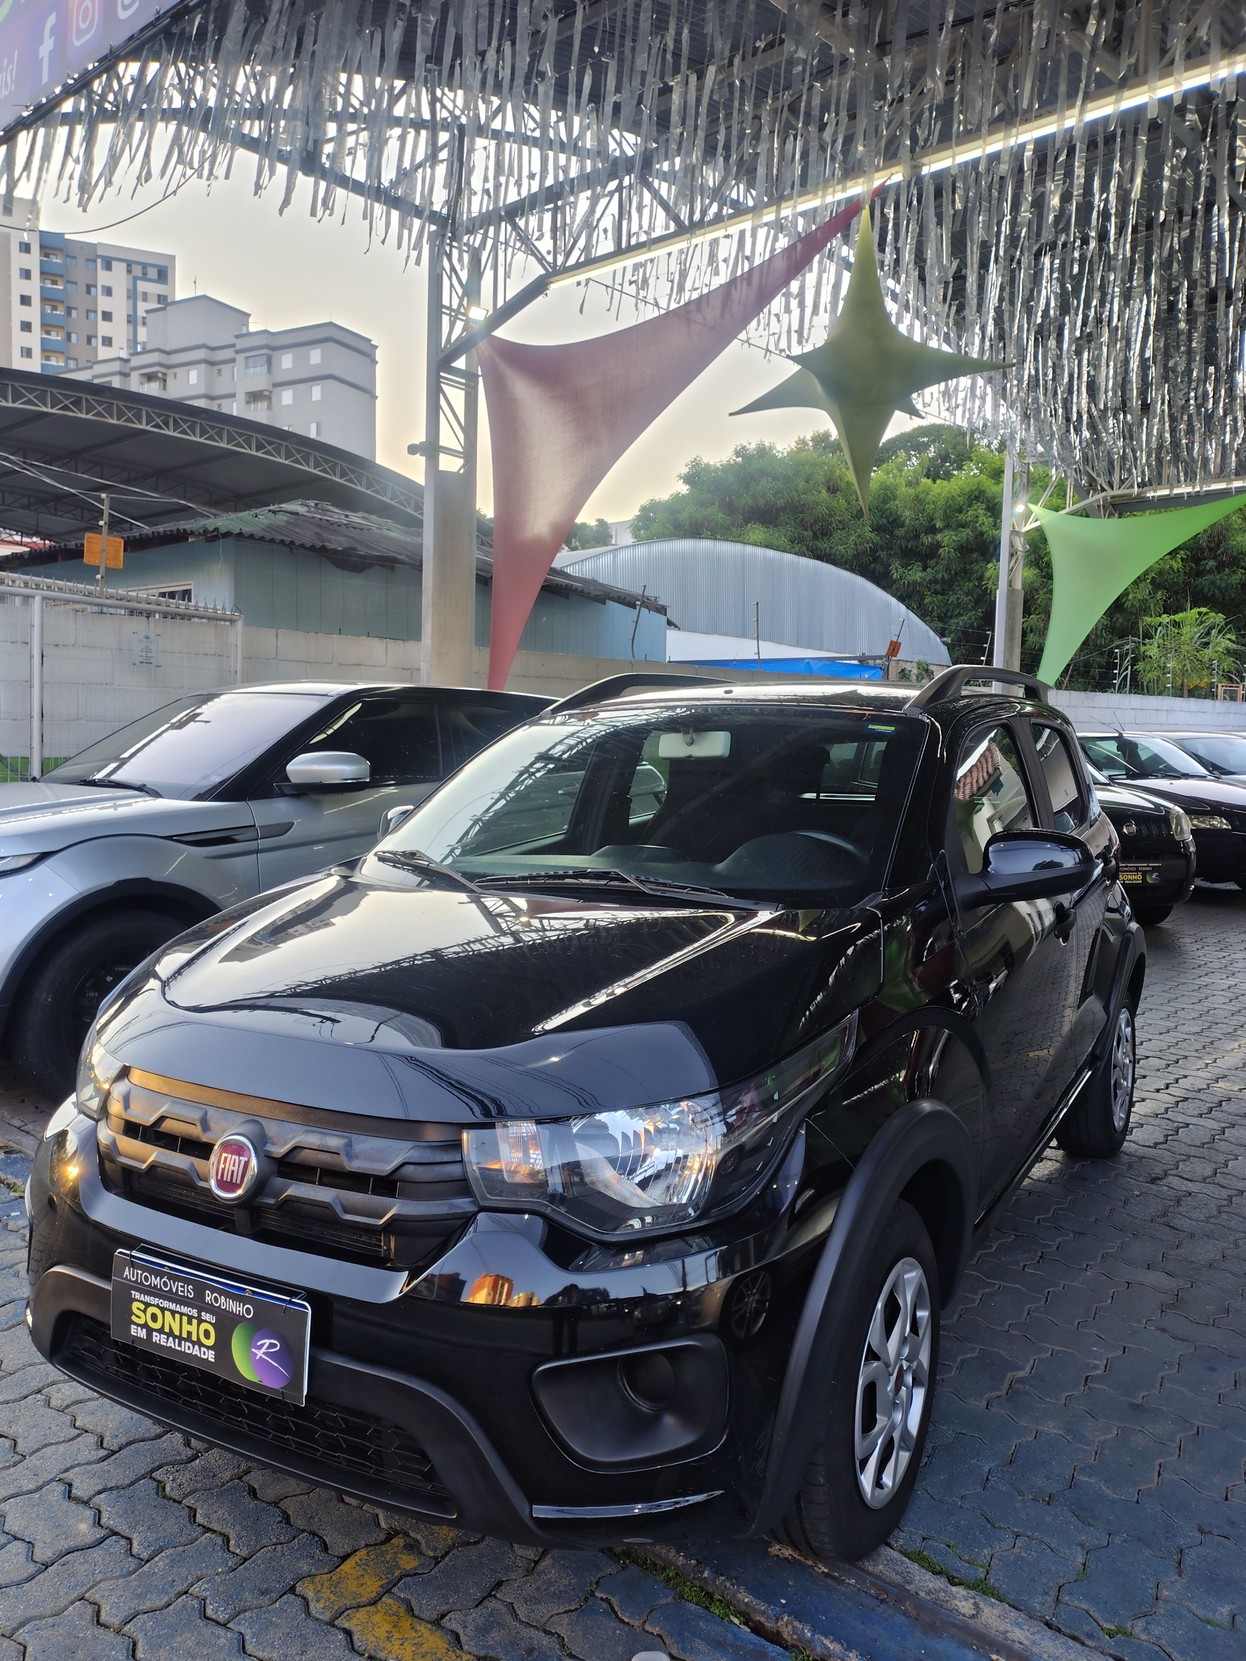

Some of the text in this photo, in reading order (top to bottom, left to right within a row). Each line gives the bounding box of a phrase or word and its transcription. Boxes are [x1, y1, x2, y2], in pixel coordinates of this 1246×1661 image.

[217, 1153, 248, 1184] FIAT
[123, 1265, 254, 1319] AUTOMÓVEIS ROBINHO
[130, 1291, 216, 1324] TRANSFORMAMOS SEU
[130, 1301, 216, 1347] SONHO
[130, 1324, 216, 1363] EM REALIDADE
